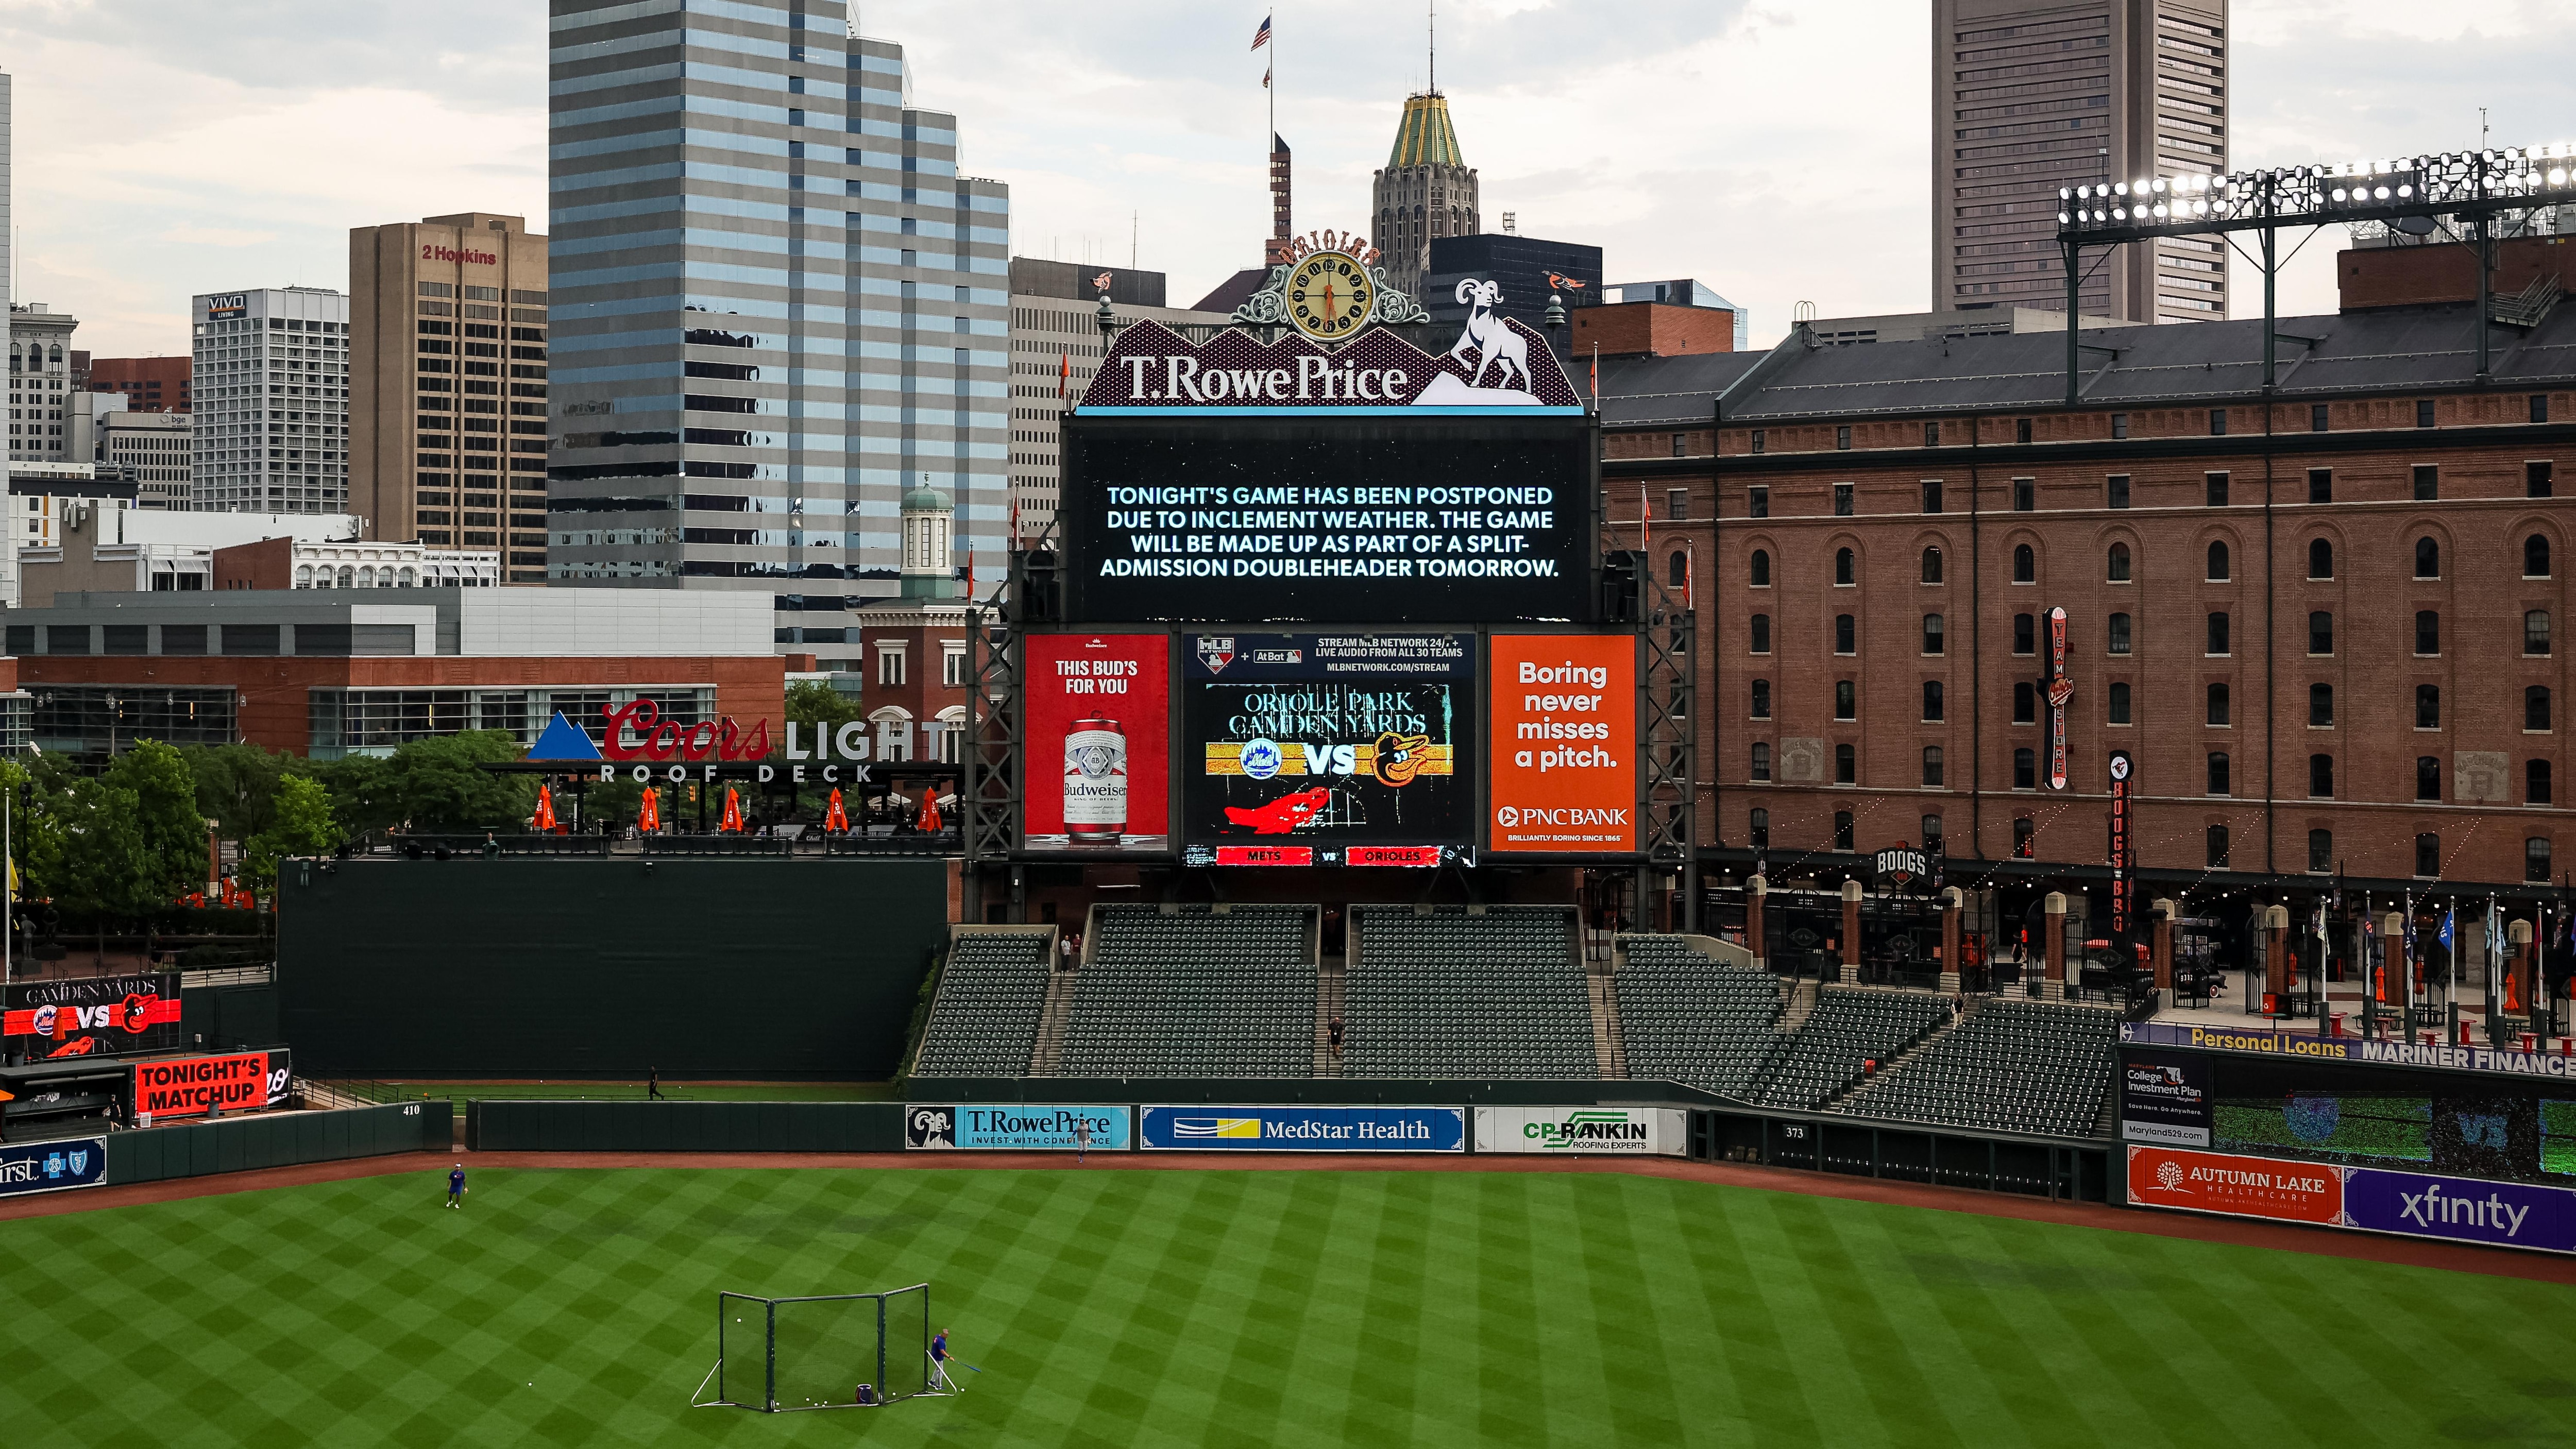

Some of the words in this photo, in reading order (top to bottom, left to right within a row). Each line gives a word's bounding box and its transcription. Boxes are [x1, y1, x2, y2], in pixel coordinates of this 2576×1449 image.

[422, 245, 431, 259] 2
[435, 246, 496, 265] Hopkins
[1280, 229, 1381, 266] ORIOLES
[1310, 263, 1319, 274] 11
[1325, 261, 1334, 271] 12
[1342, 265, 1347, 274] 1
[1297, 276, 1308, 286] 10
[1350, 276, 1360, 285] 2
[210, 296, 244, 310] VIVO
[1352, 308, 1360, 316] 4
[1310, 318, 1318, 327] 7
[1341, 318, 1348, 327] 5
[1164, 356, 1291, 402] Rowe
[1295, 356, 1408, 400] Price
[172, 415, 185, 424] bge
[1108, 487, 1227, 505] TONIGHT'S
[1233, 487, 1298, 505] GAME
[1304, 487, 1349, 505] HAS
[1355, 487, 1411, 505] BEEN
[1417, 487, 1553, 505] POSTPONED
[1108, 511, 1152, 529] DUE
[1156, 511, 1187, 529] TO
[1192, 511, 1318, 529] INCLEMENT
[1322, 511, 1435, 529] WEATHER.
[1439, 511, 1482, 529] THE
[1486, 511, 1553, 529] GAME
[1131, 535, 1182, 553] WILL
[1188, 535, 1213, 553] BE
[1219, 535, 1283, 553] MADE
[1289, 535, 1317, 553] UP
[1321, 535, 1349, 553] AS
[1355, 535, 1406, 553] PART
[1412, 535, 1442, 553] OF
[1447, 535, 1464, 553] A
[1467, 535, 1529, 553] SPLIT-
[1100, 559, 1227, 577] ADMISSION
[1234, 559, 1412, 577] DOUBLEHEADER
[1416, 559, 1558, 577] TOMORROW.
[1200, 640, 1232, 650] MLB
[1318, 638, 1358, 647] STREAM
[1381, 638, 1428, 647] NETWORK
[1316, 648, 1336, 657] LIVE
[1337, 648, 1367, 657] AUDIO
[1369, 648, 1397, 657] FROM
[1398, 648, 1415, 657] ALL
[1416, 648, 1429, 657] 30
[1430, 648, 1463, 657] TEAMS
[1056, 660, 1089, 675] THIS
[1093, 660, 1138, 676] BUD’S
[1327, 663, 1449, 672] MLBNETWORK.COM/STREAM
[1519, 660, 1607, 689] Boring
[1065, 678, 1094, 694] FOR
[1098, 678, 1128, 694] YOU
[1244, 692, 1340, 712] ORIOLE
[1349, 692, 1414, 712] PARK
[1524, 694, 1602, 712] never
[602, 698, 774, 760] Coors
[786, 721, 946, 760] LIGHT
[1346, 714, 1426, 734] YARDS
[1517, 715, 1609, 740] misses
[1248, 753, 1274, 766] Mets
[1303, 745, 1356, 775] VS
[1515, 751, 1532, 768] a
[1540, 744, 1617, 773] pitch.
[601, 765, 718, 782] ROOF
[759, 765, 872, 782] DECK
[1065, 783, 1126, 796] Budweiser
[1521, 808, 1567, 825] PNC
[1568, 808, 1628, 825] BANK
[1247, 851, 1281, 861] METS
[1322, 851, 1336, 861] VS
[1365, 851, 1421, 861] ORIOLES
[105, 980, 156, 997] YARDS
[77, 1005, 110, 1029] VS
[2192, 1028, 2278, 1053] Personal
[2285, 1035, 2346, 1058] Loans
[2363, 1041, 2469, 1068] MARINER
[2475, 1049, 2576, 1076] FINANCE
[2128, 1070, 2162, 1083] College
[149, 1084, 255, 1110] MATCHUP
[2128, 1081, 2179, 1095] Investment
[2181, 1086, 2201, 1097] Plan
[403, 1105, 420, 1116] 410
[990, 1111, 1052, 1133] Rowe
[1265, 1120, 1353, 1139] MedStar
[1358, 1120, 1431, 1139] Health
[972, 1136, 1008, 1145] INVEST
[1013, 1136, 1039, 1145] WITH
[1044, 1137, 1110, 1145] CONFINCE
[1786, 1128, 1804, 1138] 373
[2129, 1126, 2202, 1140] Maryland529.com
[2190, 1167, 2270, 1187] AUTUMN
[2276, 1175, 2325, 1193] LAKE
[2208, 1185, 2307, 1202] HEALTHCARE
[2401, 1184, 2529, 1236] xfinity
